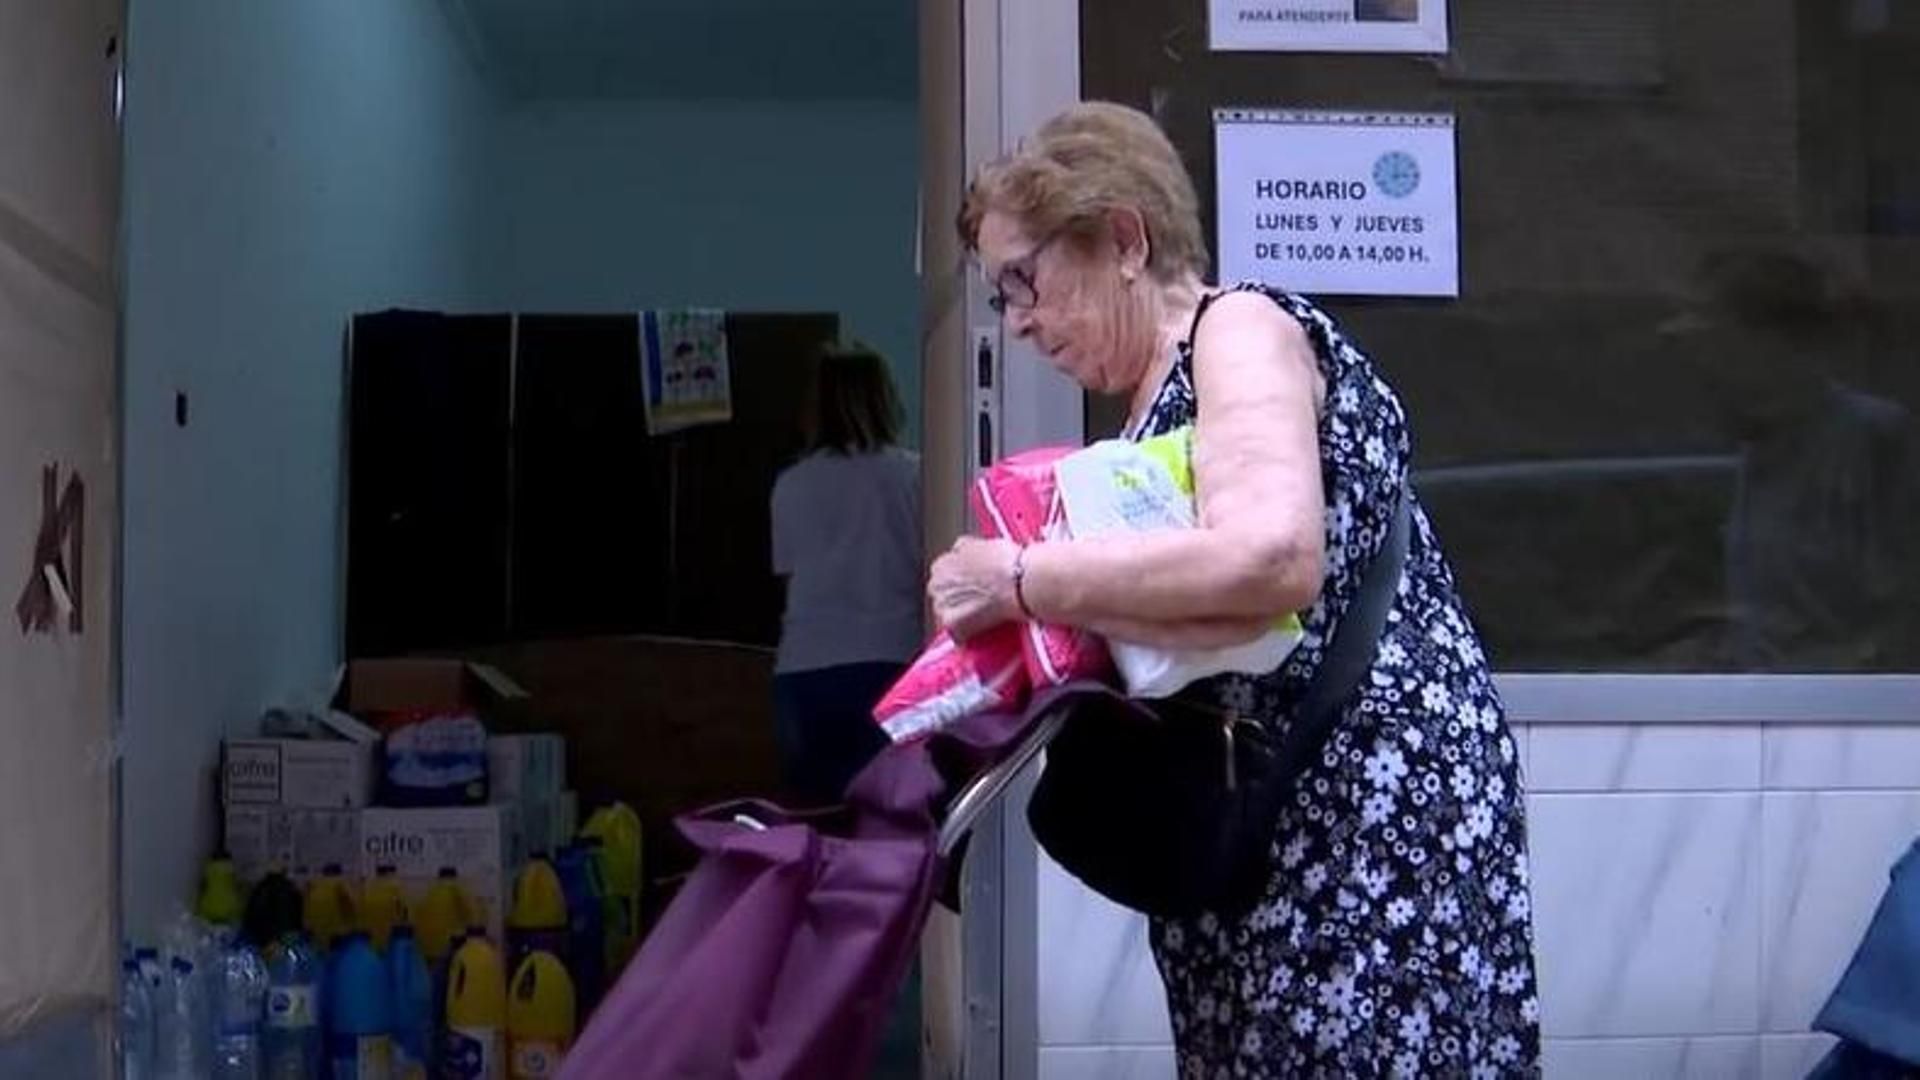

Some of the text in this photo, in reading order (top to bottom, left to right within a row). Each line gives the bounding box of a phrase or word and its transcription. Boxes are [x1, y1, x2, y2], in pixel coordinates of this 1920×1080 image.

[1239, 10, 1273, 23] PARA
[1255, 179, 1367, 201] HORARIO
[1255, 213, 1424, 233] LUNES Y JUEVES
[1255, 243, 1430, 264] DE 10,00 A 14,00 H.
